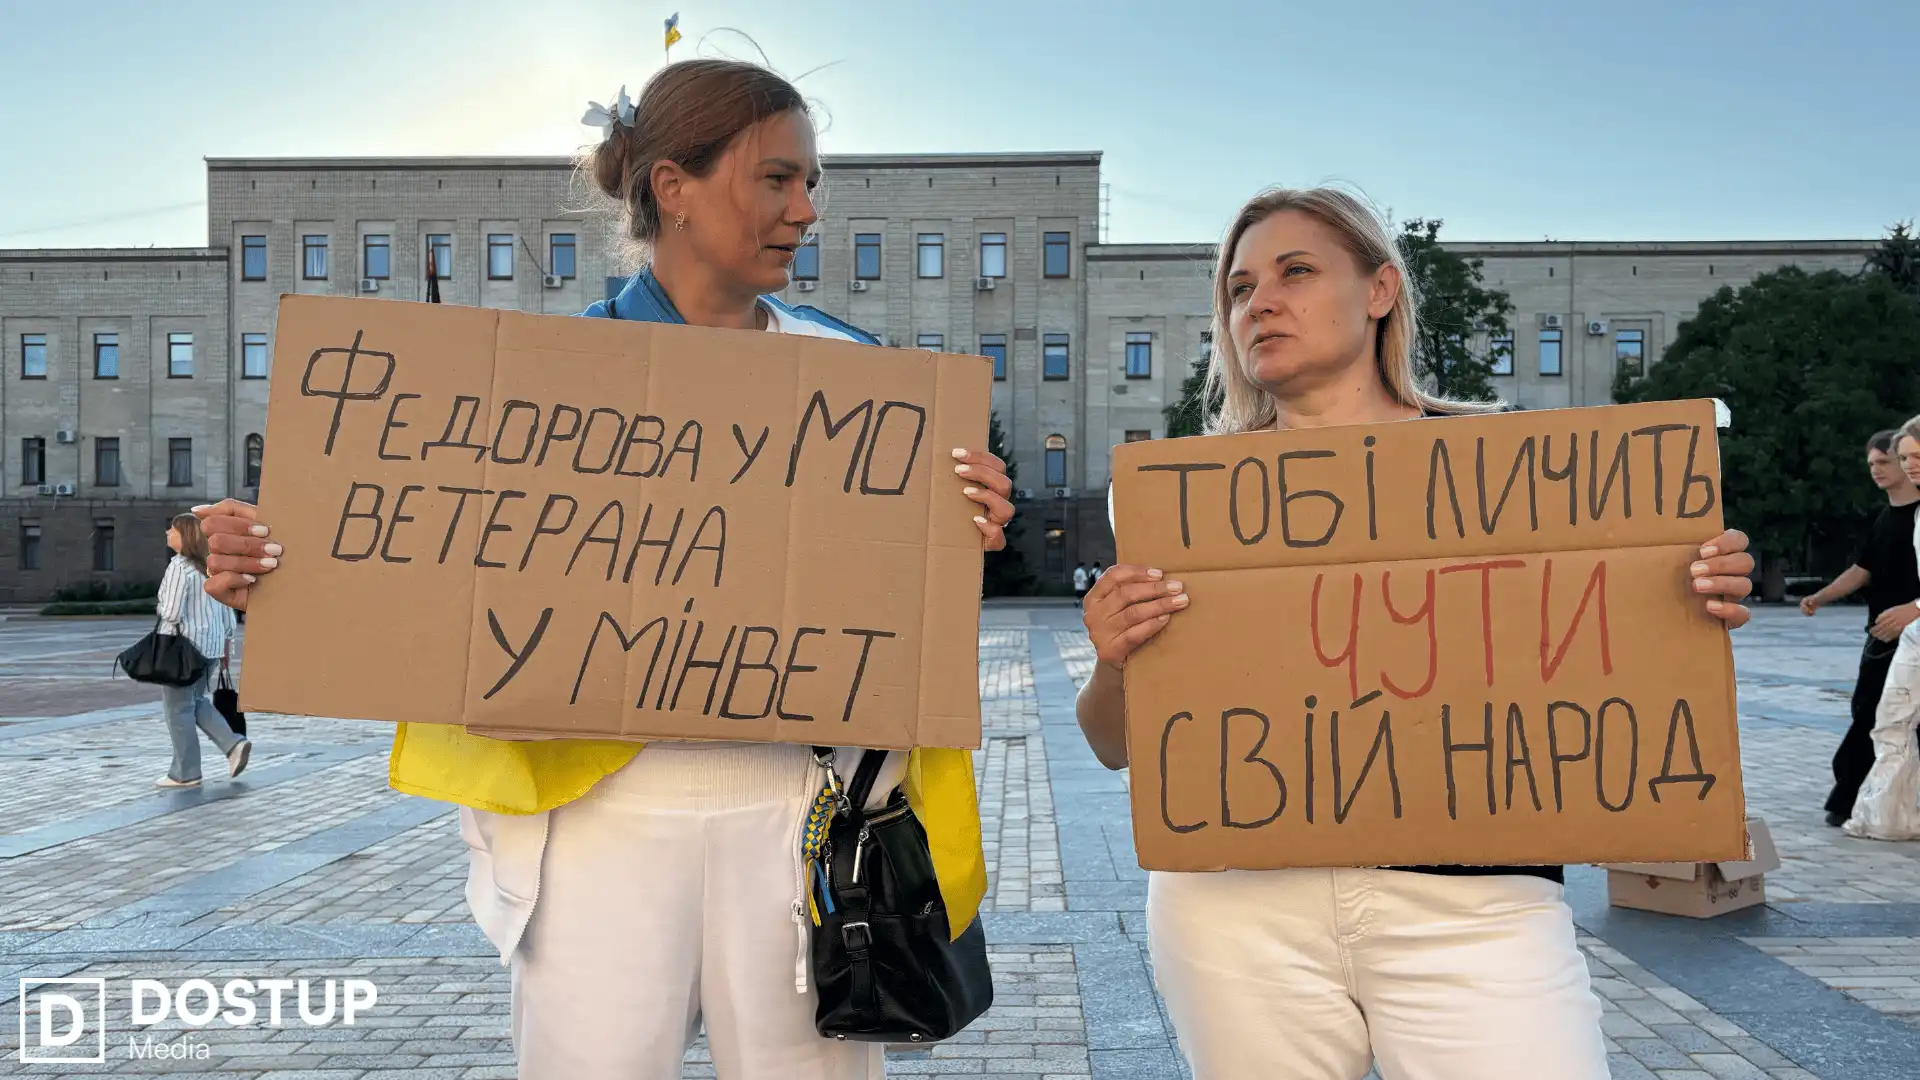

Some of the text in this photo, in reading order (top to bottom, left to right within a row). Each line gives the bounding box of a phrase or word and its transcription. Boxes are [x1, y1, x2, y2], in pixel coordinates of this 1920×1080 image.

[786, 390, 926, 495] МО
[1426, 425, 1715, 540] ЛИЧИТЬ
[331, 482, 727, 587] ВЕТЕРАНА
[483, 607, 553, 701] У
[1311, 559, 1613, 700] ЧУТИ
[1441, 697, 1717, 820] НАРОД
